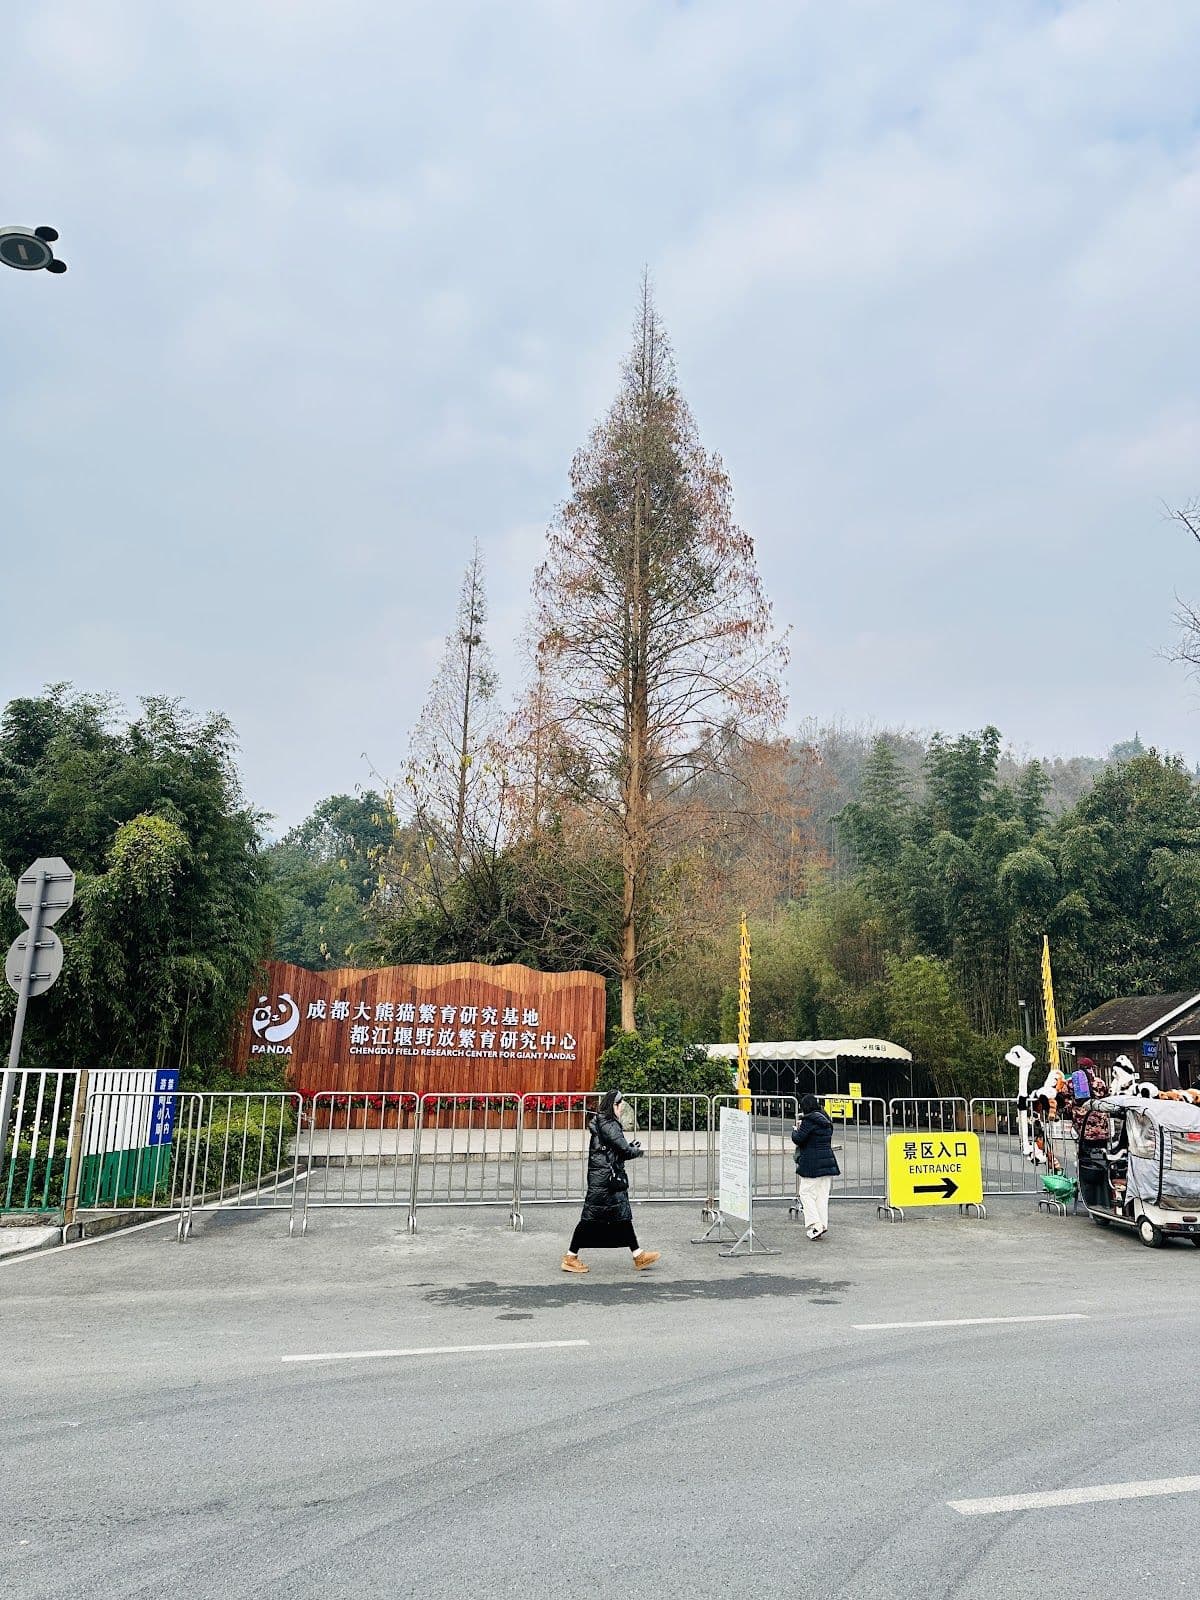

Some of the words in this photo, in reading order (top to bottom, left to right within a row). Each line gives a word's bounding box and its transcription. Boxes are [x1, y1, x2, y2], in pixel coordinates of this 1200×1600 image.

[306, 1000, 539, 1026] 成都大熊猫繁育研究基地
[350, 1024, 577, 1050] 都江堰野放繁育研究中心
[251, 1044, 293, 1054] PANDA
[349, 1047, 394, 1055] CHENGDU
[395, 1048, 419, 1056] FIELD
[420, 1049, 465, 1058] RESEARCH
[466, 1050, 499, 1059] CENTER
[516, 1052, 543, 1060] GIANT
[543, 1053, 577, 1061] PANDAS
[903, 1141, 967, 1160] 景区入口
[909, 1163, 962, 1174] ENTRANCE
